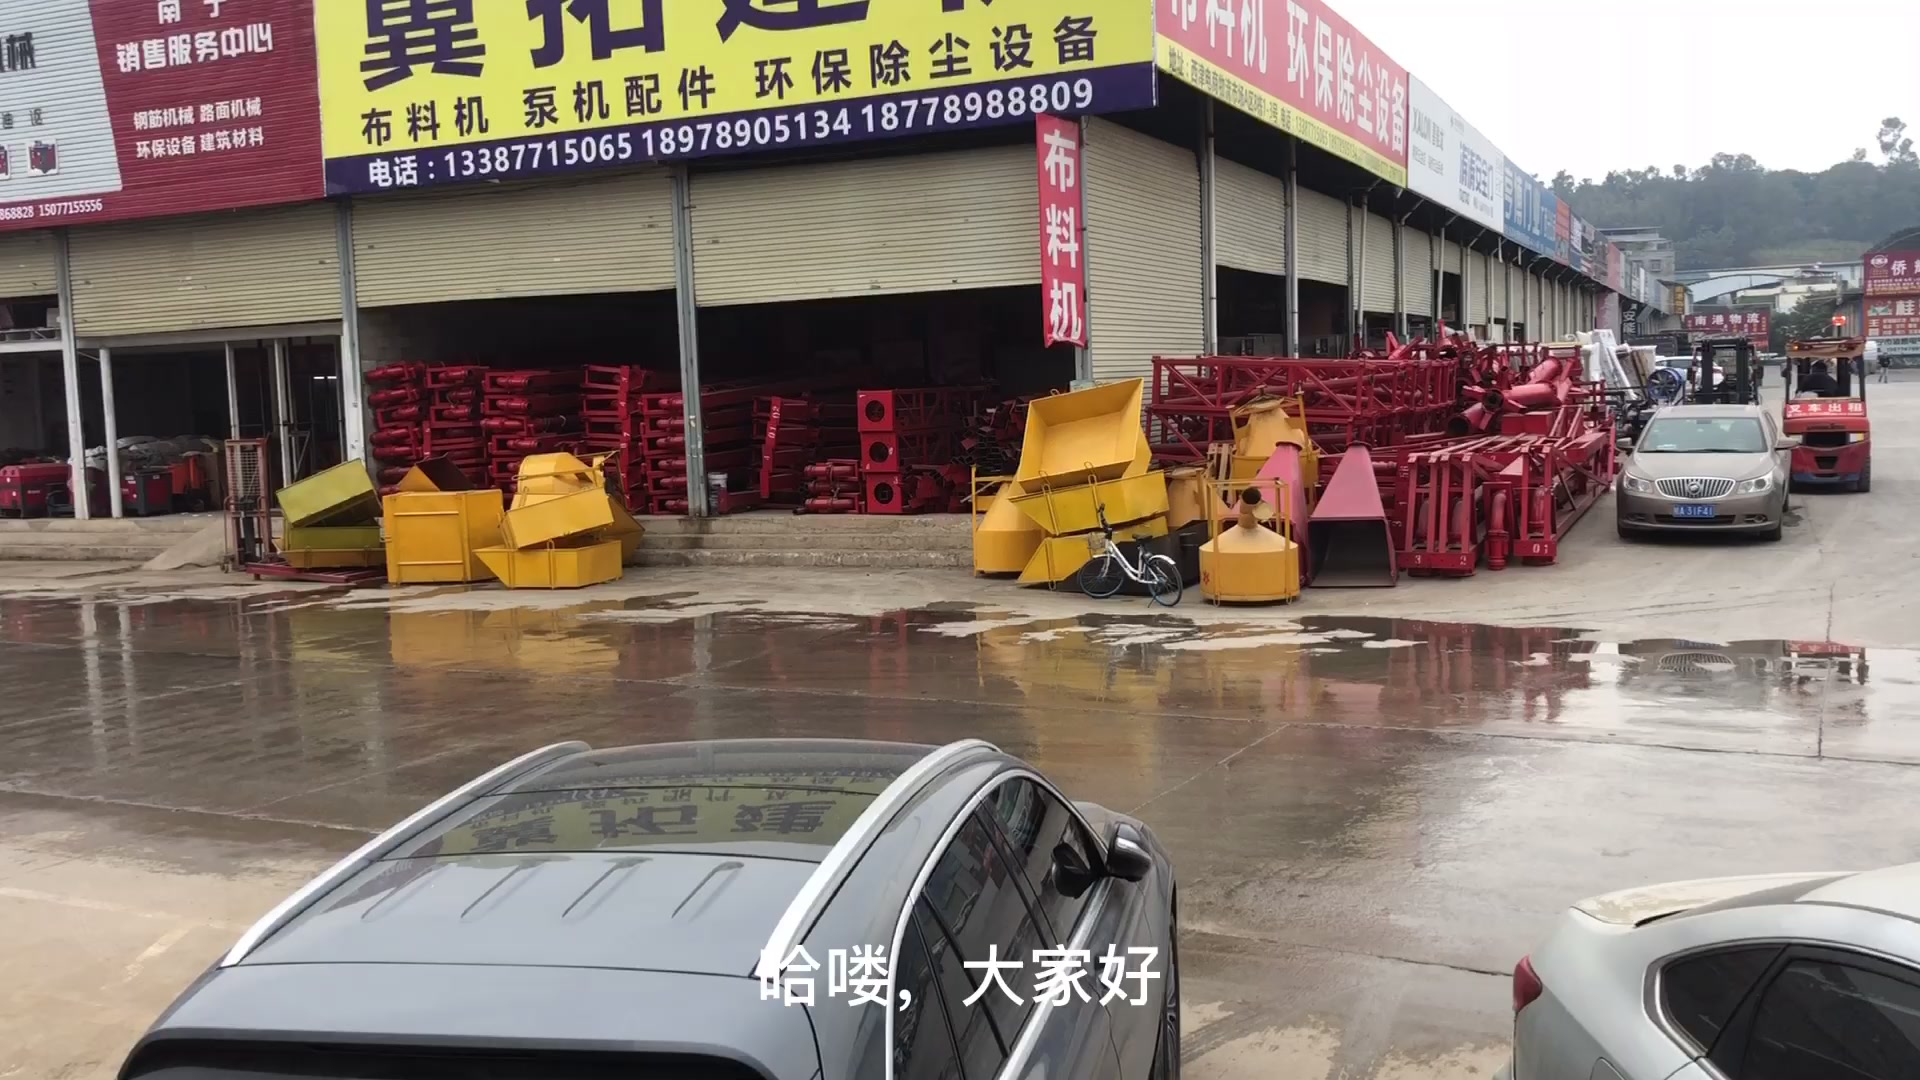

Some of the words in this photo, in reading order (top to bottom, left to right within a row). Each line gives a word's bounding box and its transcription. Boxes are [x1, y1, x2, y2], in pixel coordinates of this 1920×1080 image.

[0, 32, 36, 73] 械
[116, 23, 273, 73] 销售服务中心
[361, 96, 489, 147] 布料机
[522, 65, 716, 128] 泵机配件
[754, 15, 1098, 100] 环保除尘设备
[1286, 0, 1405, 156] 环保除尘设备
[133, 106, 195, 131] 钢筋机械
[200, 97, 262, 122] 路面机械
[642, 108, 851, 157] 18978905134
[861, 78, 1093, 133] 18778988809
[136, 135, 196, 159] 环保设备
[200, 126, 264, 152] 建筑材料
[39, 198, 103, 217] 15077155556
[1043, 129, 1081, 340] 布料机
[1694, 312, 1760, 326] 南港物流
[1789, 402, 1863, 414] 叉车出租
